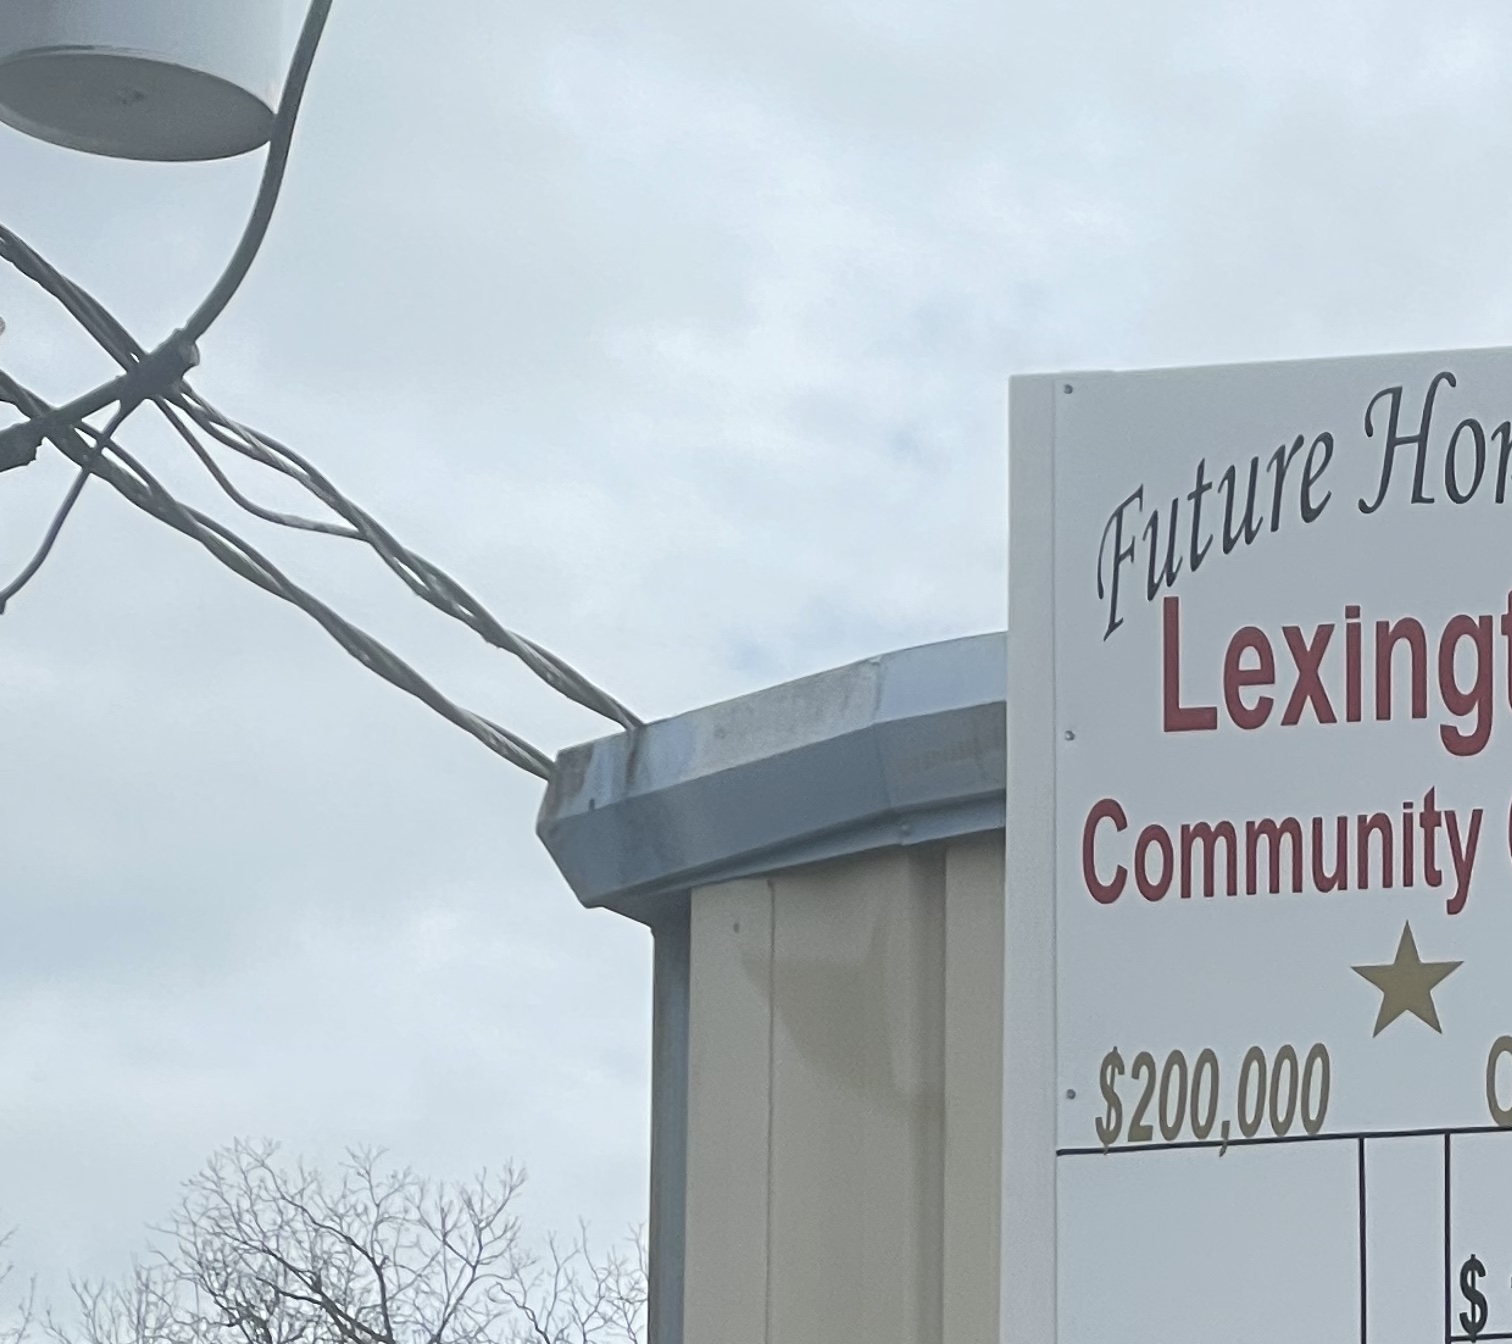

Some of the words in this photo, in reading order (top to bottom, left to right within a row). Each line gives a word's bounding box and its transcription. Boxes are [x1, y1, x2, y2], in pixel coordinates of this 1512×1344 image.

[1097, 430, 1334, 641] Future
[1083, 787, 1483, 914] Community
[1095, 1042, 1330, 1157] $200,000
